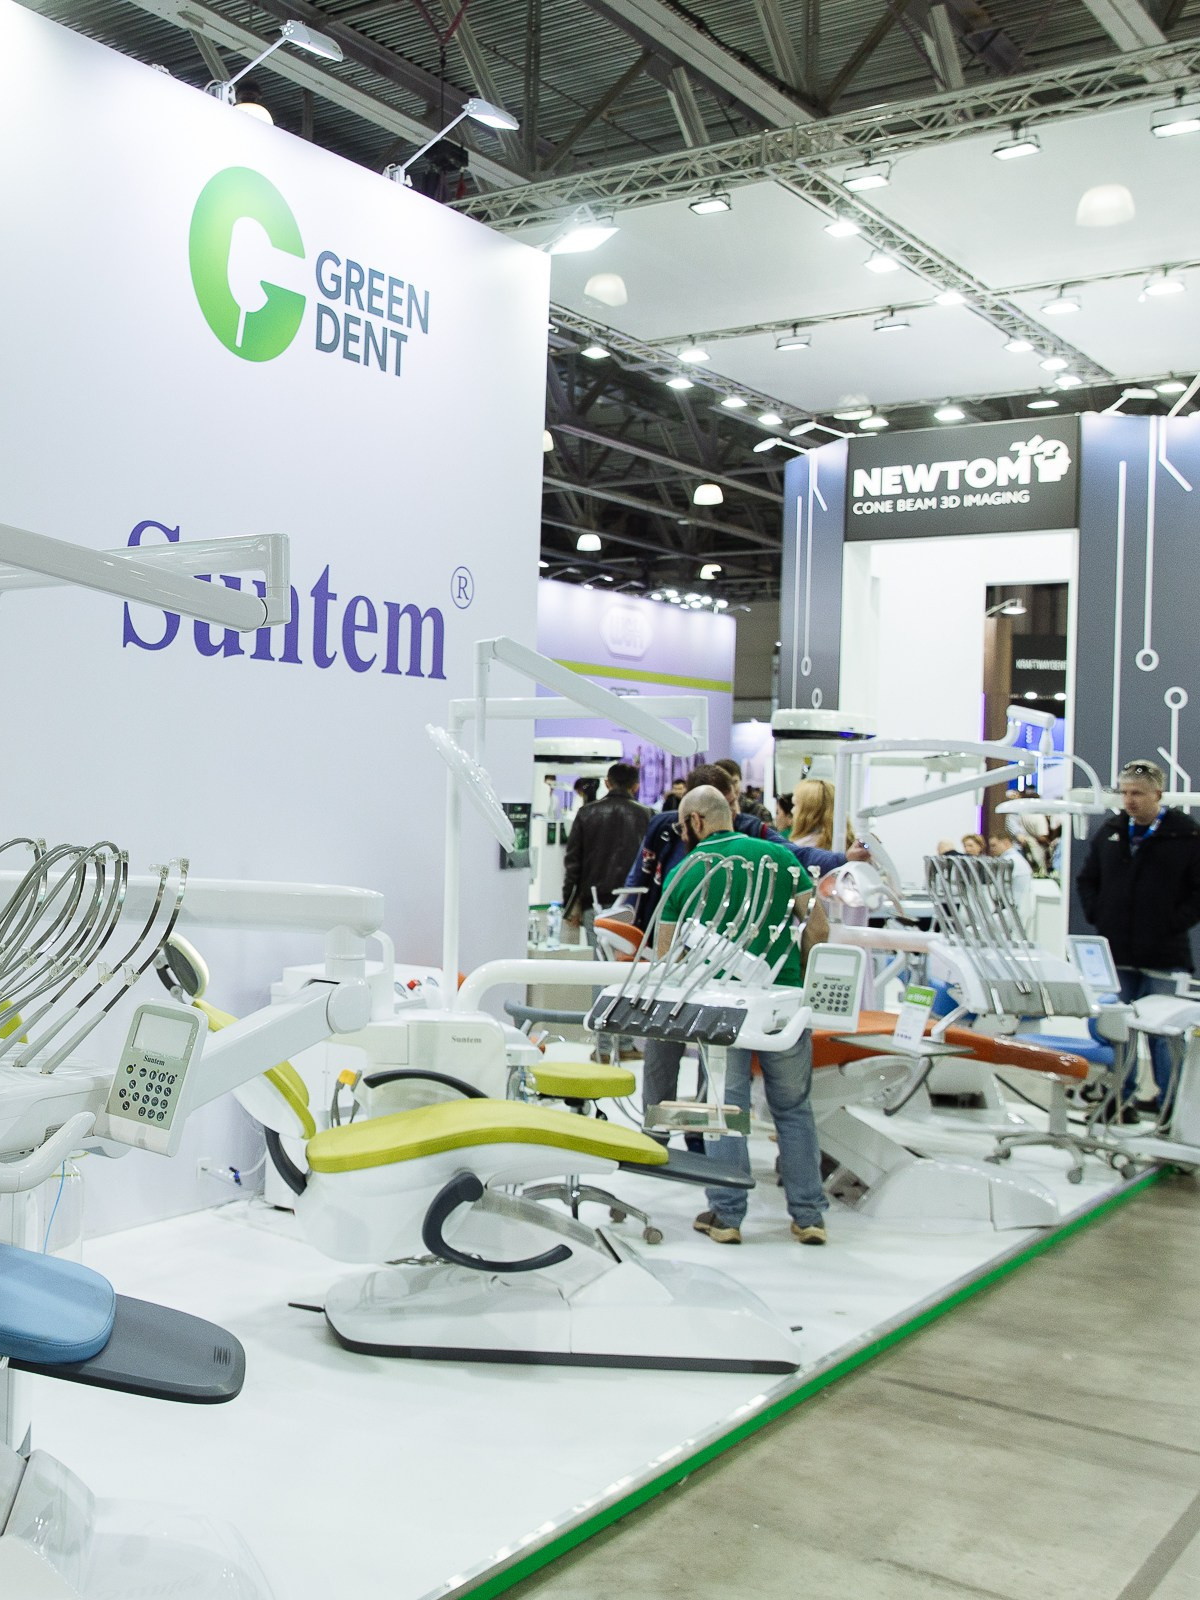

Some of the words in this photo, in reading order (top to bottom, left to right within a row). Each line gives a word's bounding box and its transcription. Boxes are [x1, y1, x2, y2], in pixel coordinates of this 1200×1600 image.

[315, 250, 430, 334] GREEN
[315, 303, 408, 377] DENT
[852, 456, 1032, 498] NEWTOM
[852, 501, 893, 515] CONE
[896, 498, 937, 512] BEAM
[940, 495, 961, 509] 3D
[964, 490, 1030, 507] IMAGING
[451, 1034, 483, 1044] Suntem
[143, 1054, 166, 1067] Suntem
